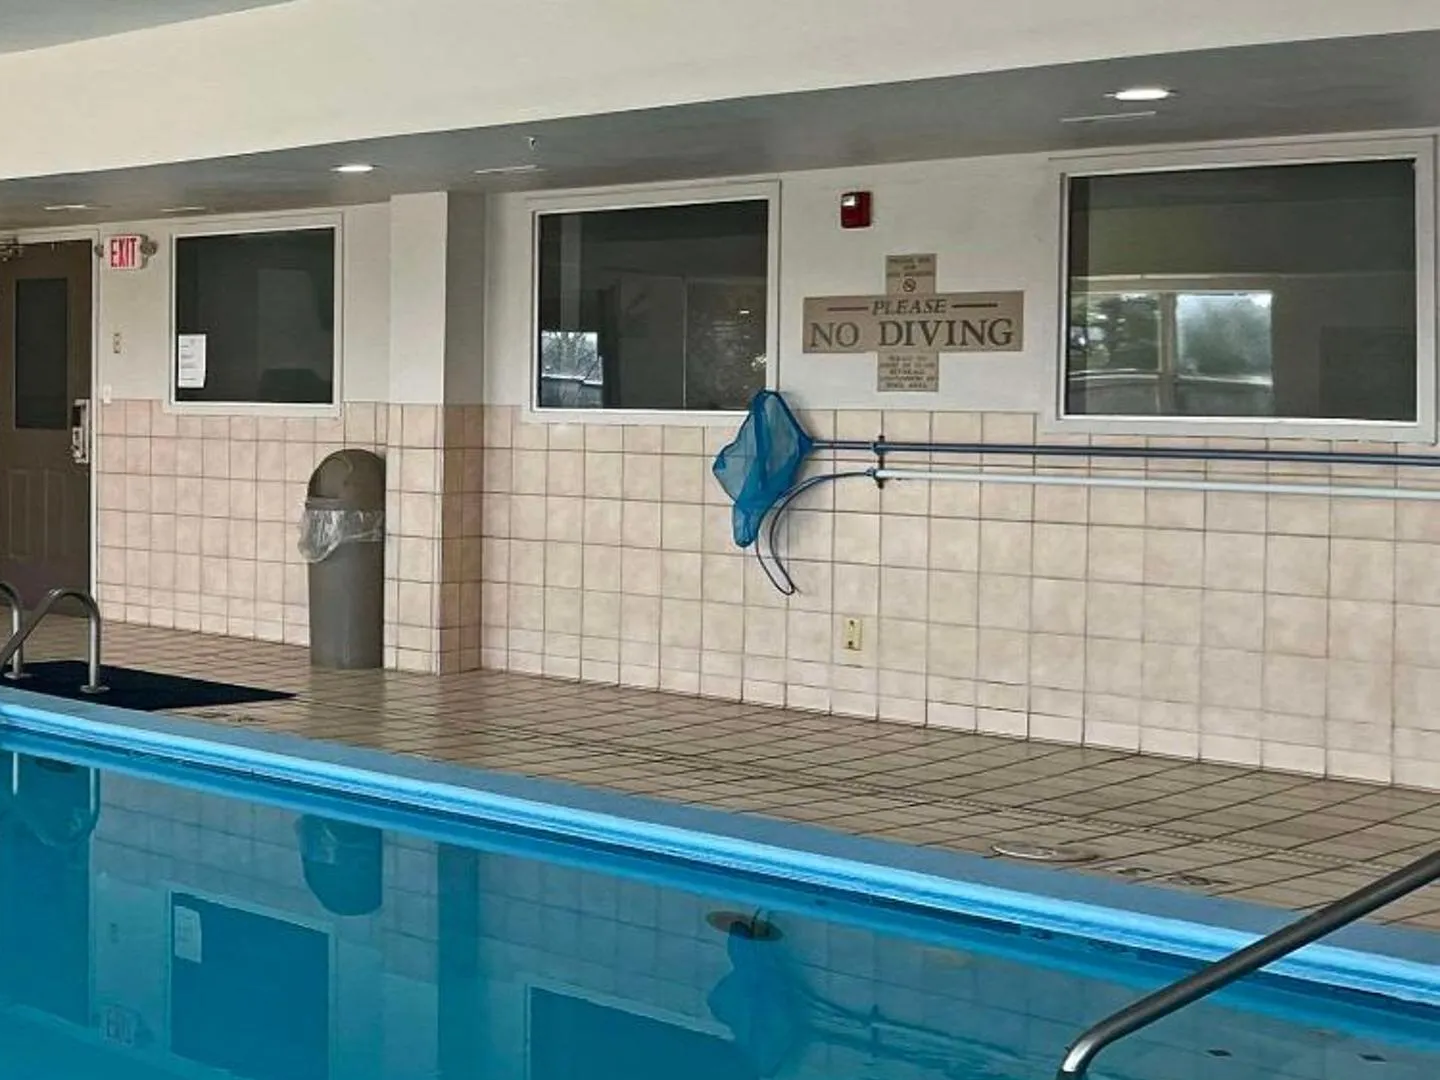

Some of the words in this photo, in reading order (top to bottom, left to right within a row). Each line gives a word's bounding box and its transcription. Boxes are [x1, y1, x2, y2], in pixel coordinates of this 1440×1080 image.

[111, 238, 136, 267] EXIT
[872, 299, 947, 315] PLEASE
[810, 322, 859, 348] NO
[878, 318, 1012, 347] DIVING
